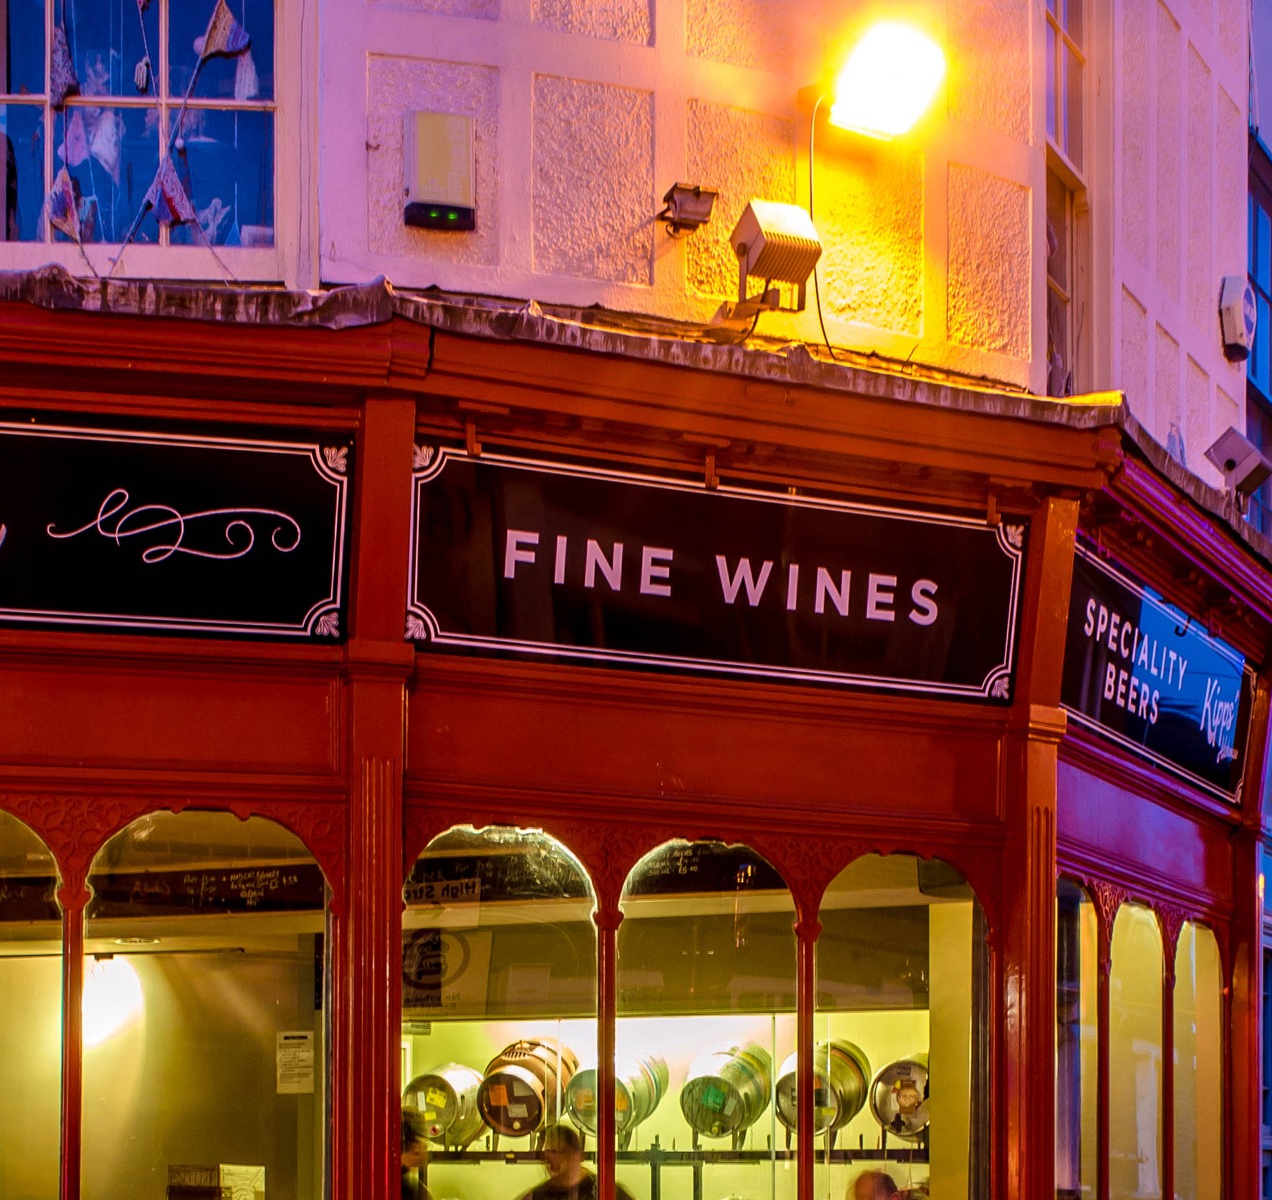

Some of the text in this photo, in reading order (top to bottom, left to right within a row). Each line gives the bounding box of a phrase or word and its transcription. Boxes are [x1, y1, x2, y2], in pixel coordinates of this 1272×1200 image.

[502, 528, 941, 628] FINE WINES
[1083, 598, 1189, 692] SPECIALITY
[1103, 662, 1160, 725] BEERS
